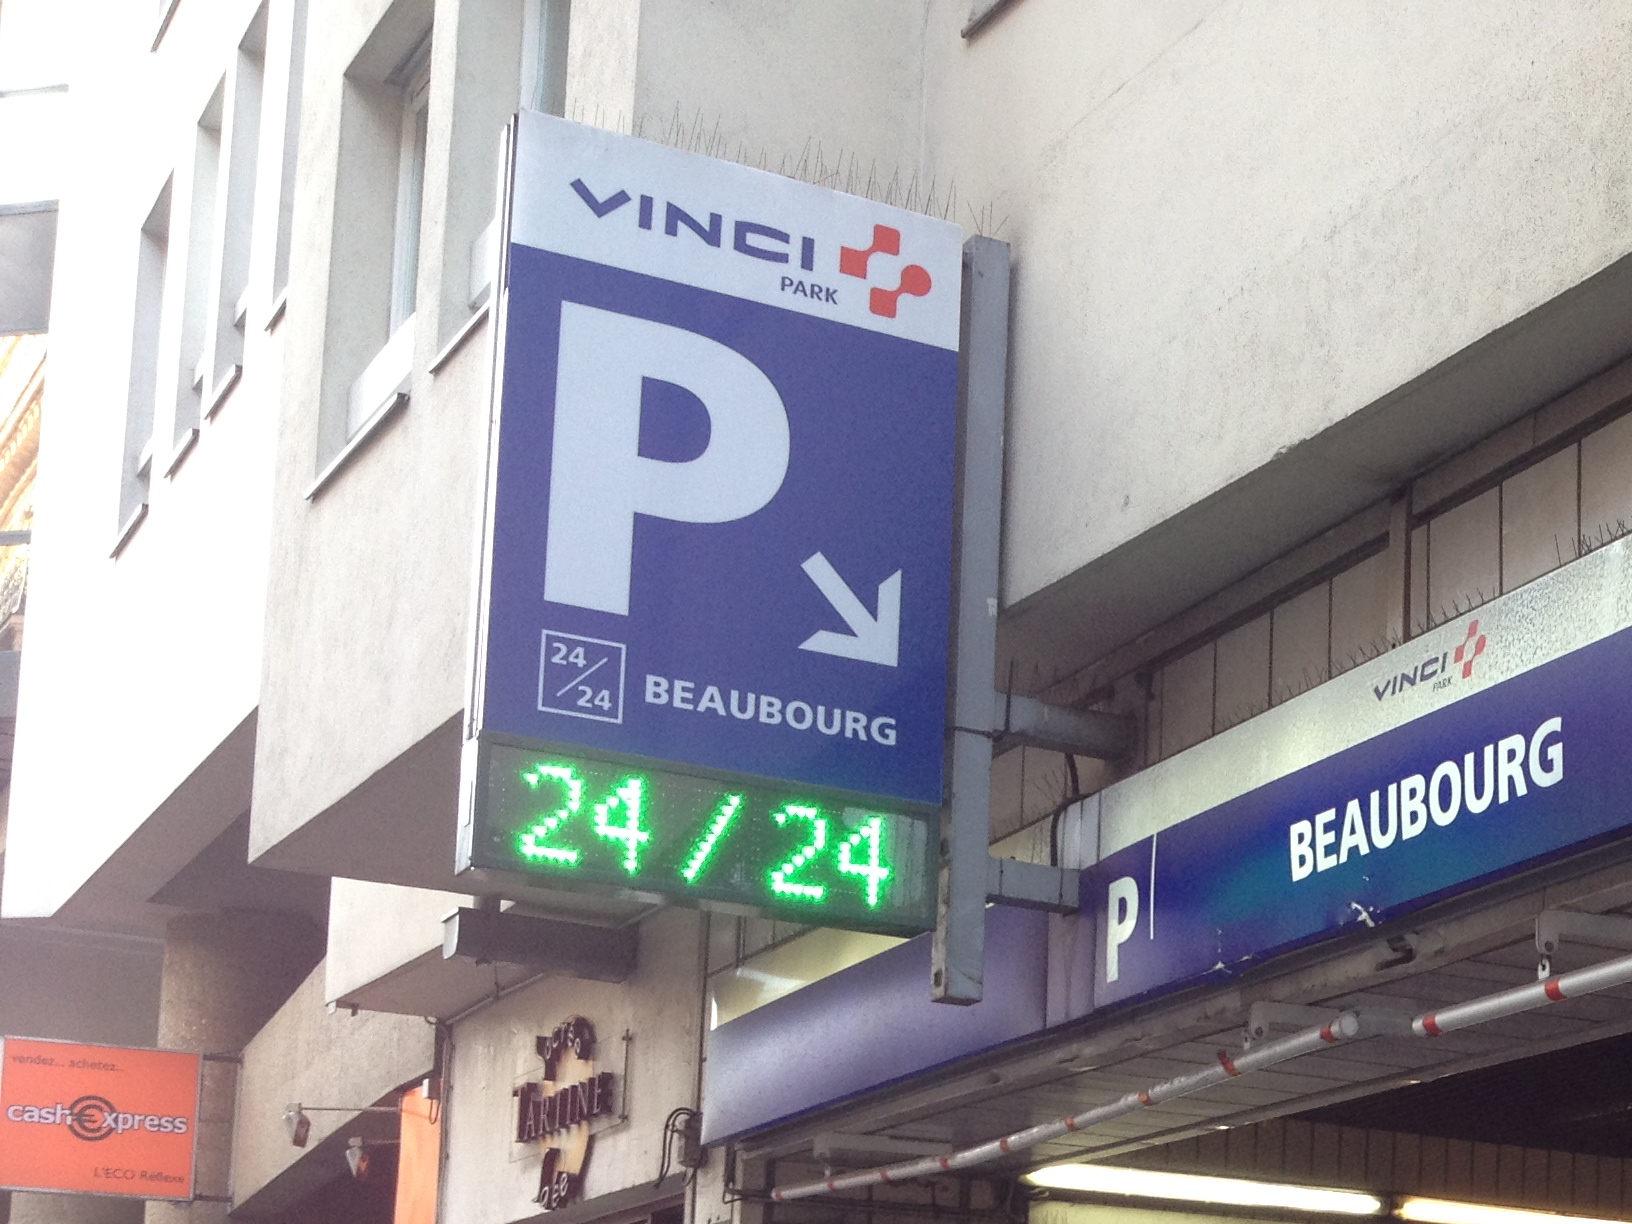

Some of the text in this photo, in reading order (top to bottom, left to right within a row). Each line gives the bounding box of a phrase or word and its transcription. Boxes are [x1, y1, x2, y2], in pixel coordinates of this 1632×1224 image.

[569, 177, 815, 272] VINCI
[780, 274, 839, 307] PARK
[543, 300, 791, 617] P
[551, 642, 587, 670] 24
[1374, 651, 1448, 702] VINCI
[1432, 676, 1454, 693] PARK
[576, 684, 612, 712] 24
[644, 674, 898, 747] BEAUBOURG
[1289, 717, 1564, 883] BEAUBOURG
[517, 763, 651, 876] 24
[769, 803, 891, 911] 24
[1106, 876, 1139, 983] P
